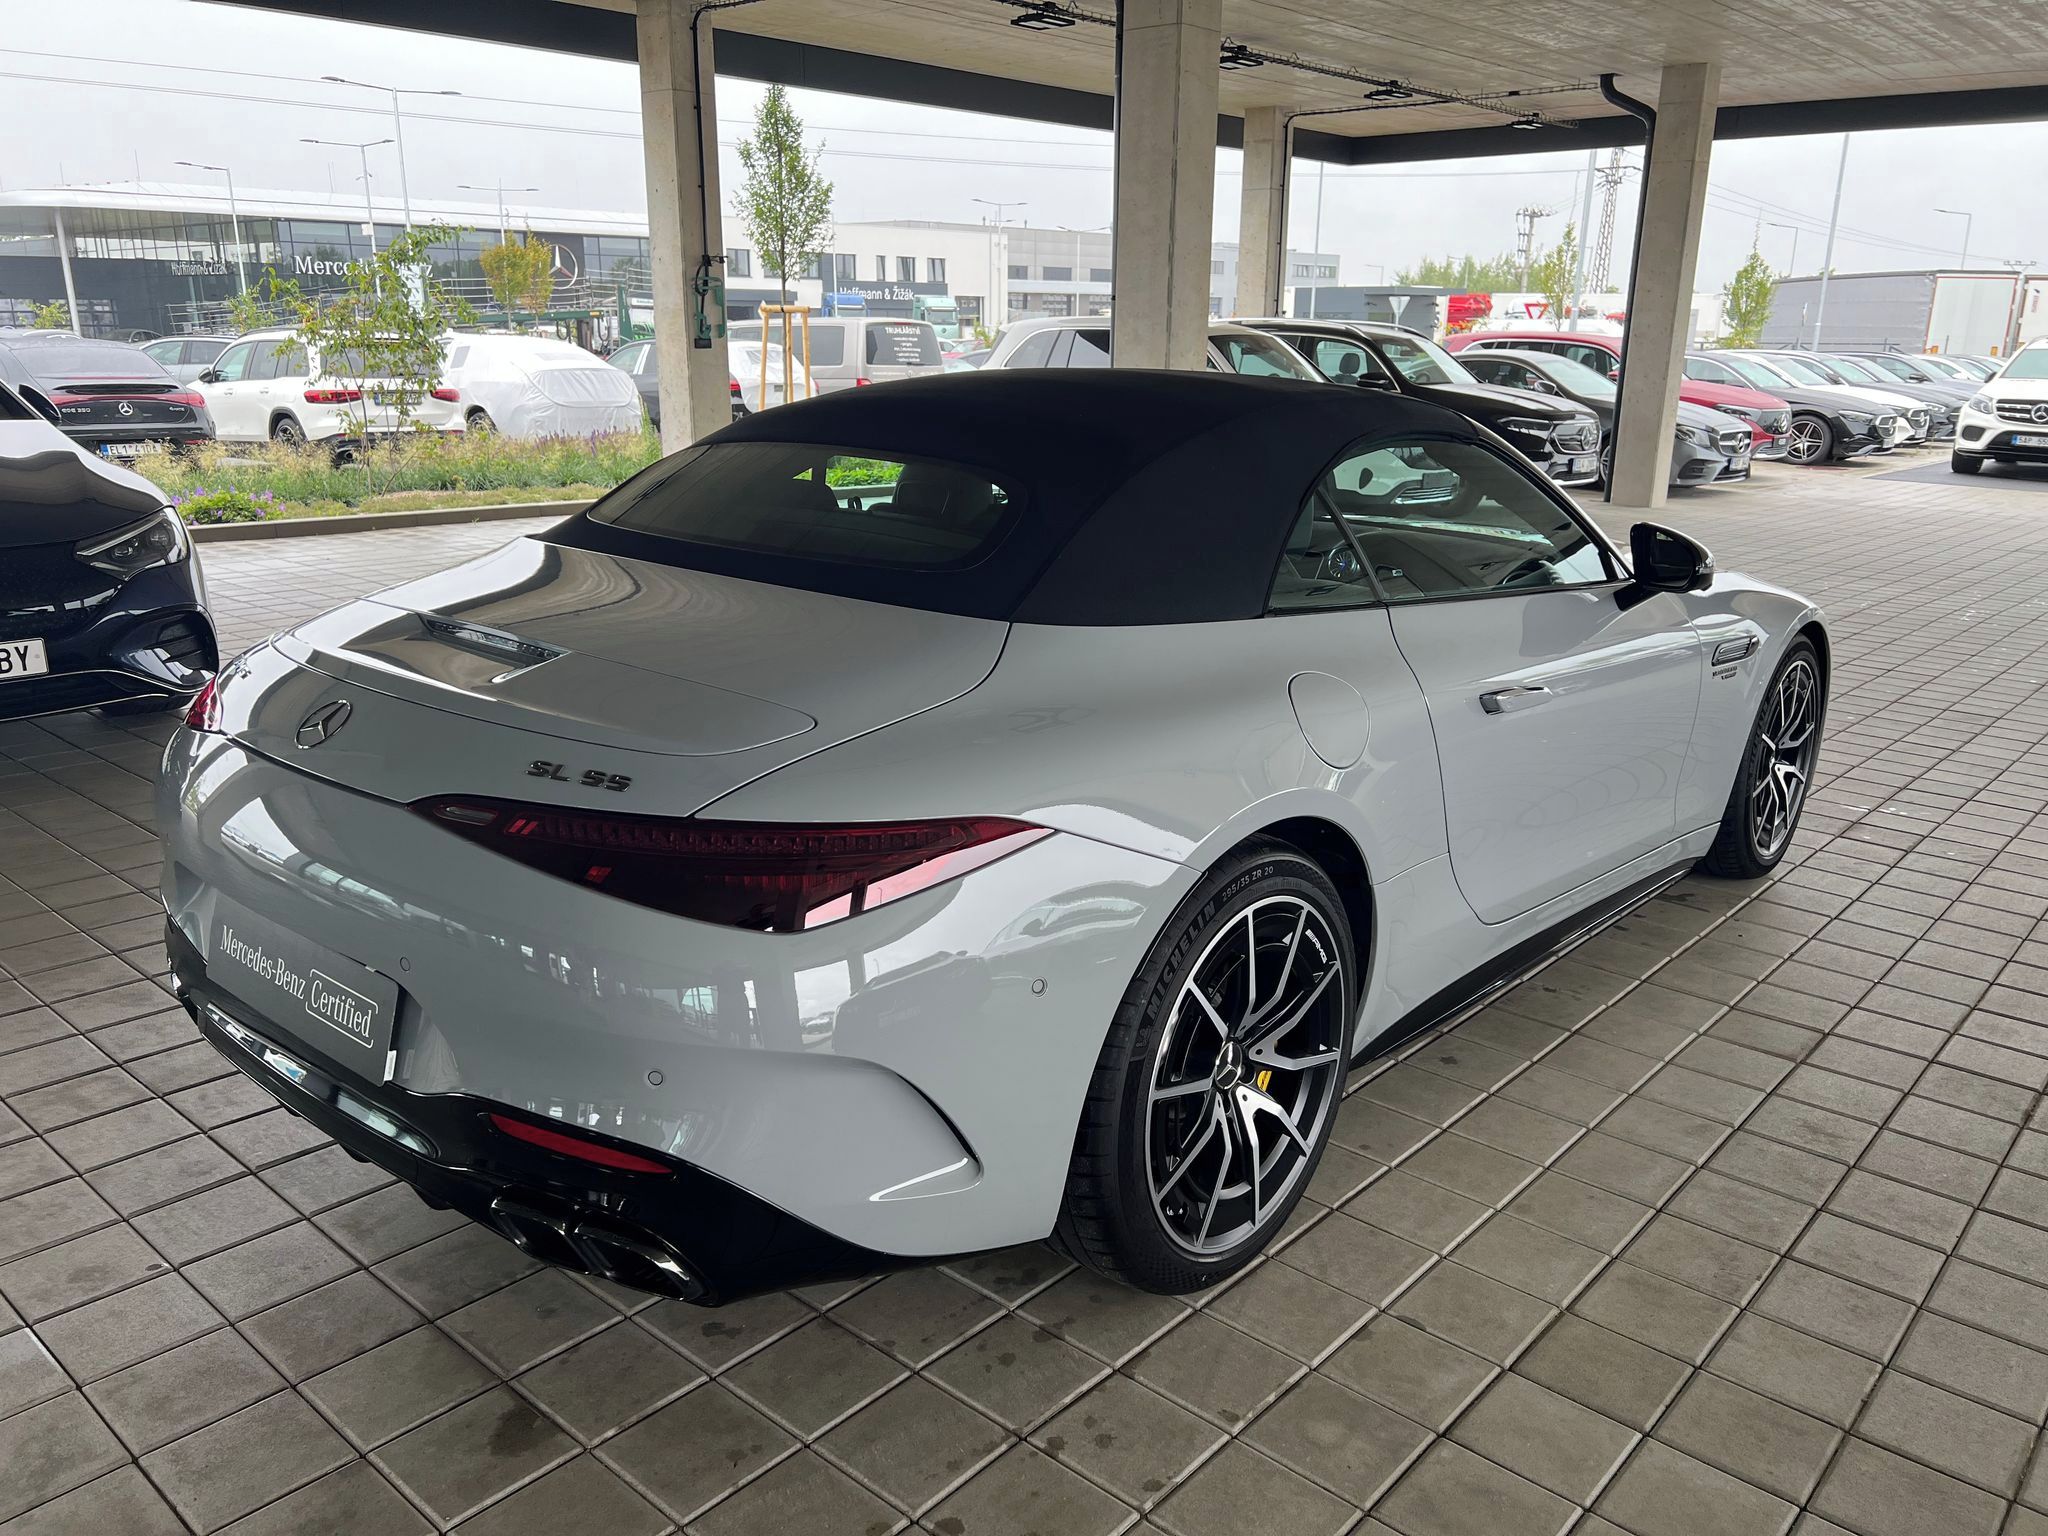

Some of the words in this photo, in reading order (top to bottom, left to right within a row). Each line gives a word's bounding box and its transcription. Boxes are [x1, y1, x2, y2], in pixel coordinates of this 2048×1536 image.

[884, 287, 891, 300] &
[892, 285, 914, 301] Žižák
[0, 645, 28, 674] BY
[524, 760, 571, 782] SL
[1222, 875, 1250, 901] 295/35
[1251, 869, 1263, 881] ZR
[1264, 866, 1274, 876] 20
[1147, 900, 1217, 1020] MICHELIN
[220, 925, 307, 1000] Mercedes-Benz
[311, 979, 372, 1038] Certified
